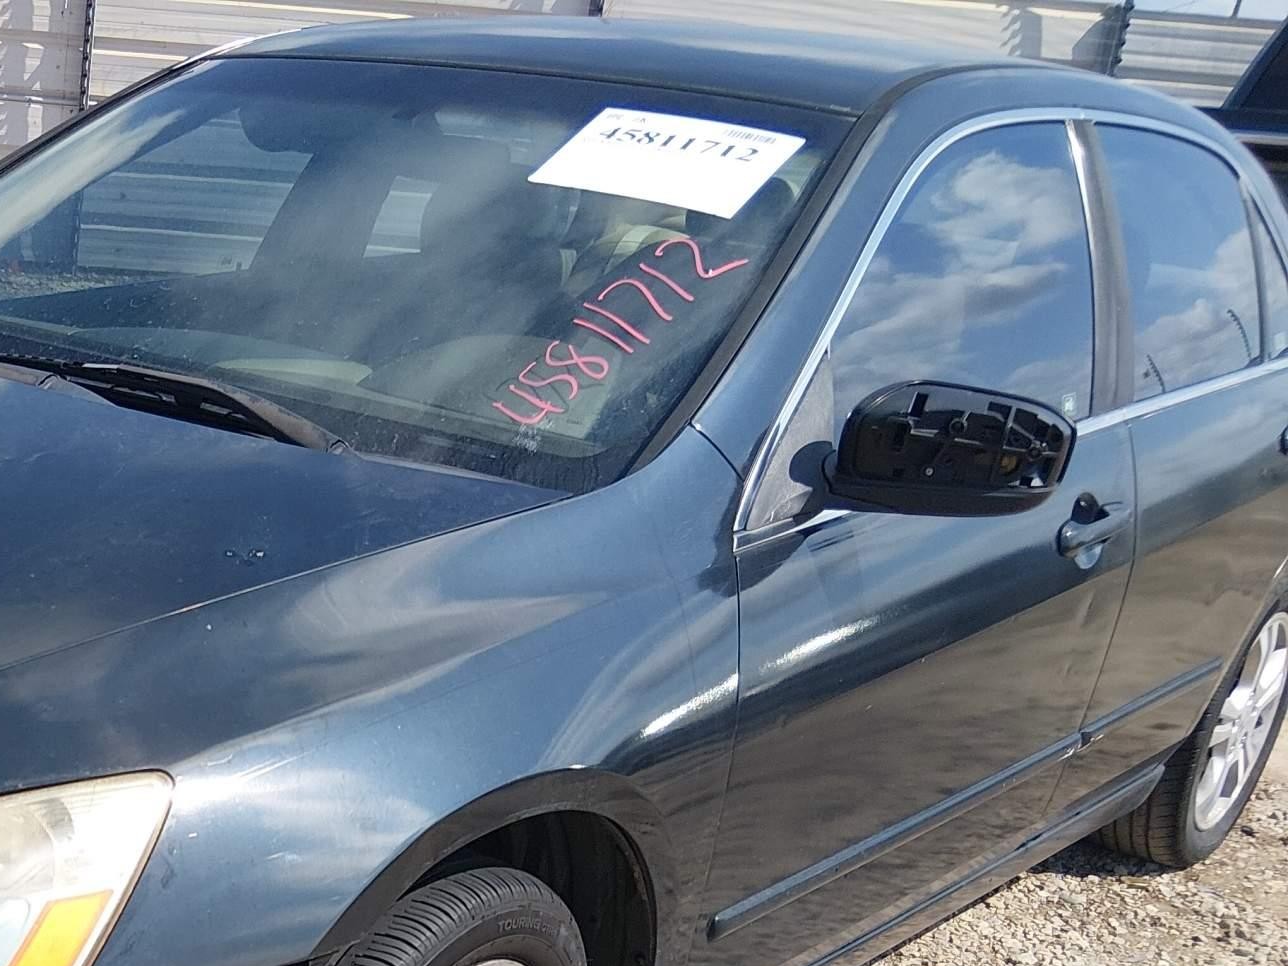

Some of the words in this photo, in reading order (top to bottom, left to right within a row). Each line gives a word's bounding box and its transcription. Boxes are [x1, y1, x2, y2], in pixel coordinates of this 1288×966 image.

[599, 126, 760, 163] 45811712
[492, 237, 749, 426] 45811712
[497, 915, 541, 935] TOURING
